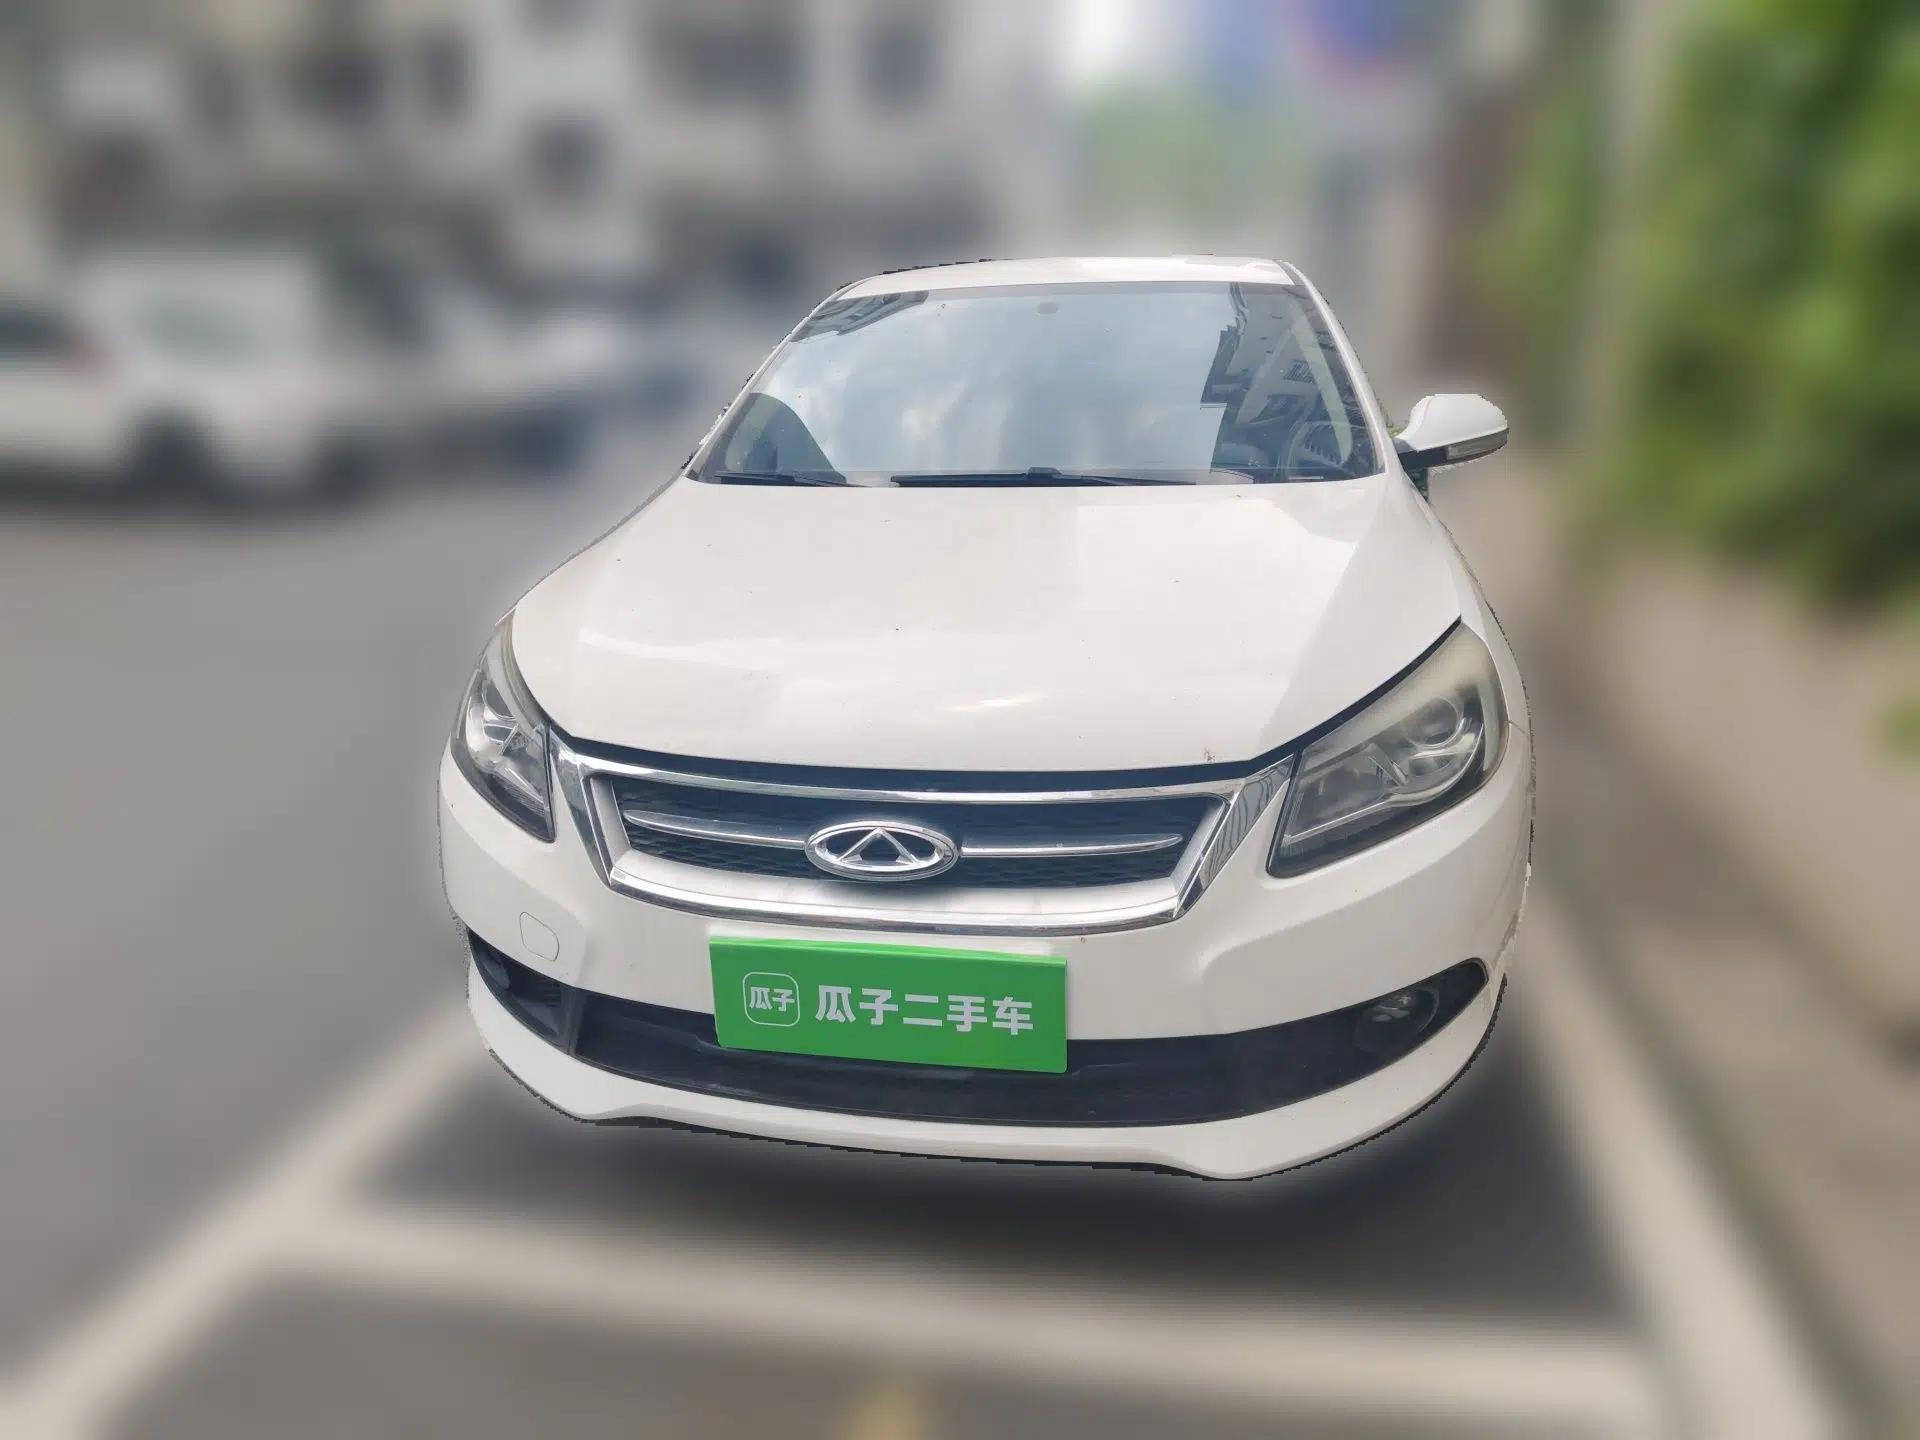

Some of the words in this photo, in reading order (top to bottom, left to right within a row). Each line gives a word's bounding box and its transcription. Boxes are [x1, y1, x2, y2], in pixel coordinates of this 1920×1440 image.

[749, 985, 795, 1012] 瓜子
[815, 985, 1034, 1035] 瓜子二手车
